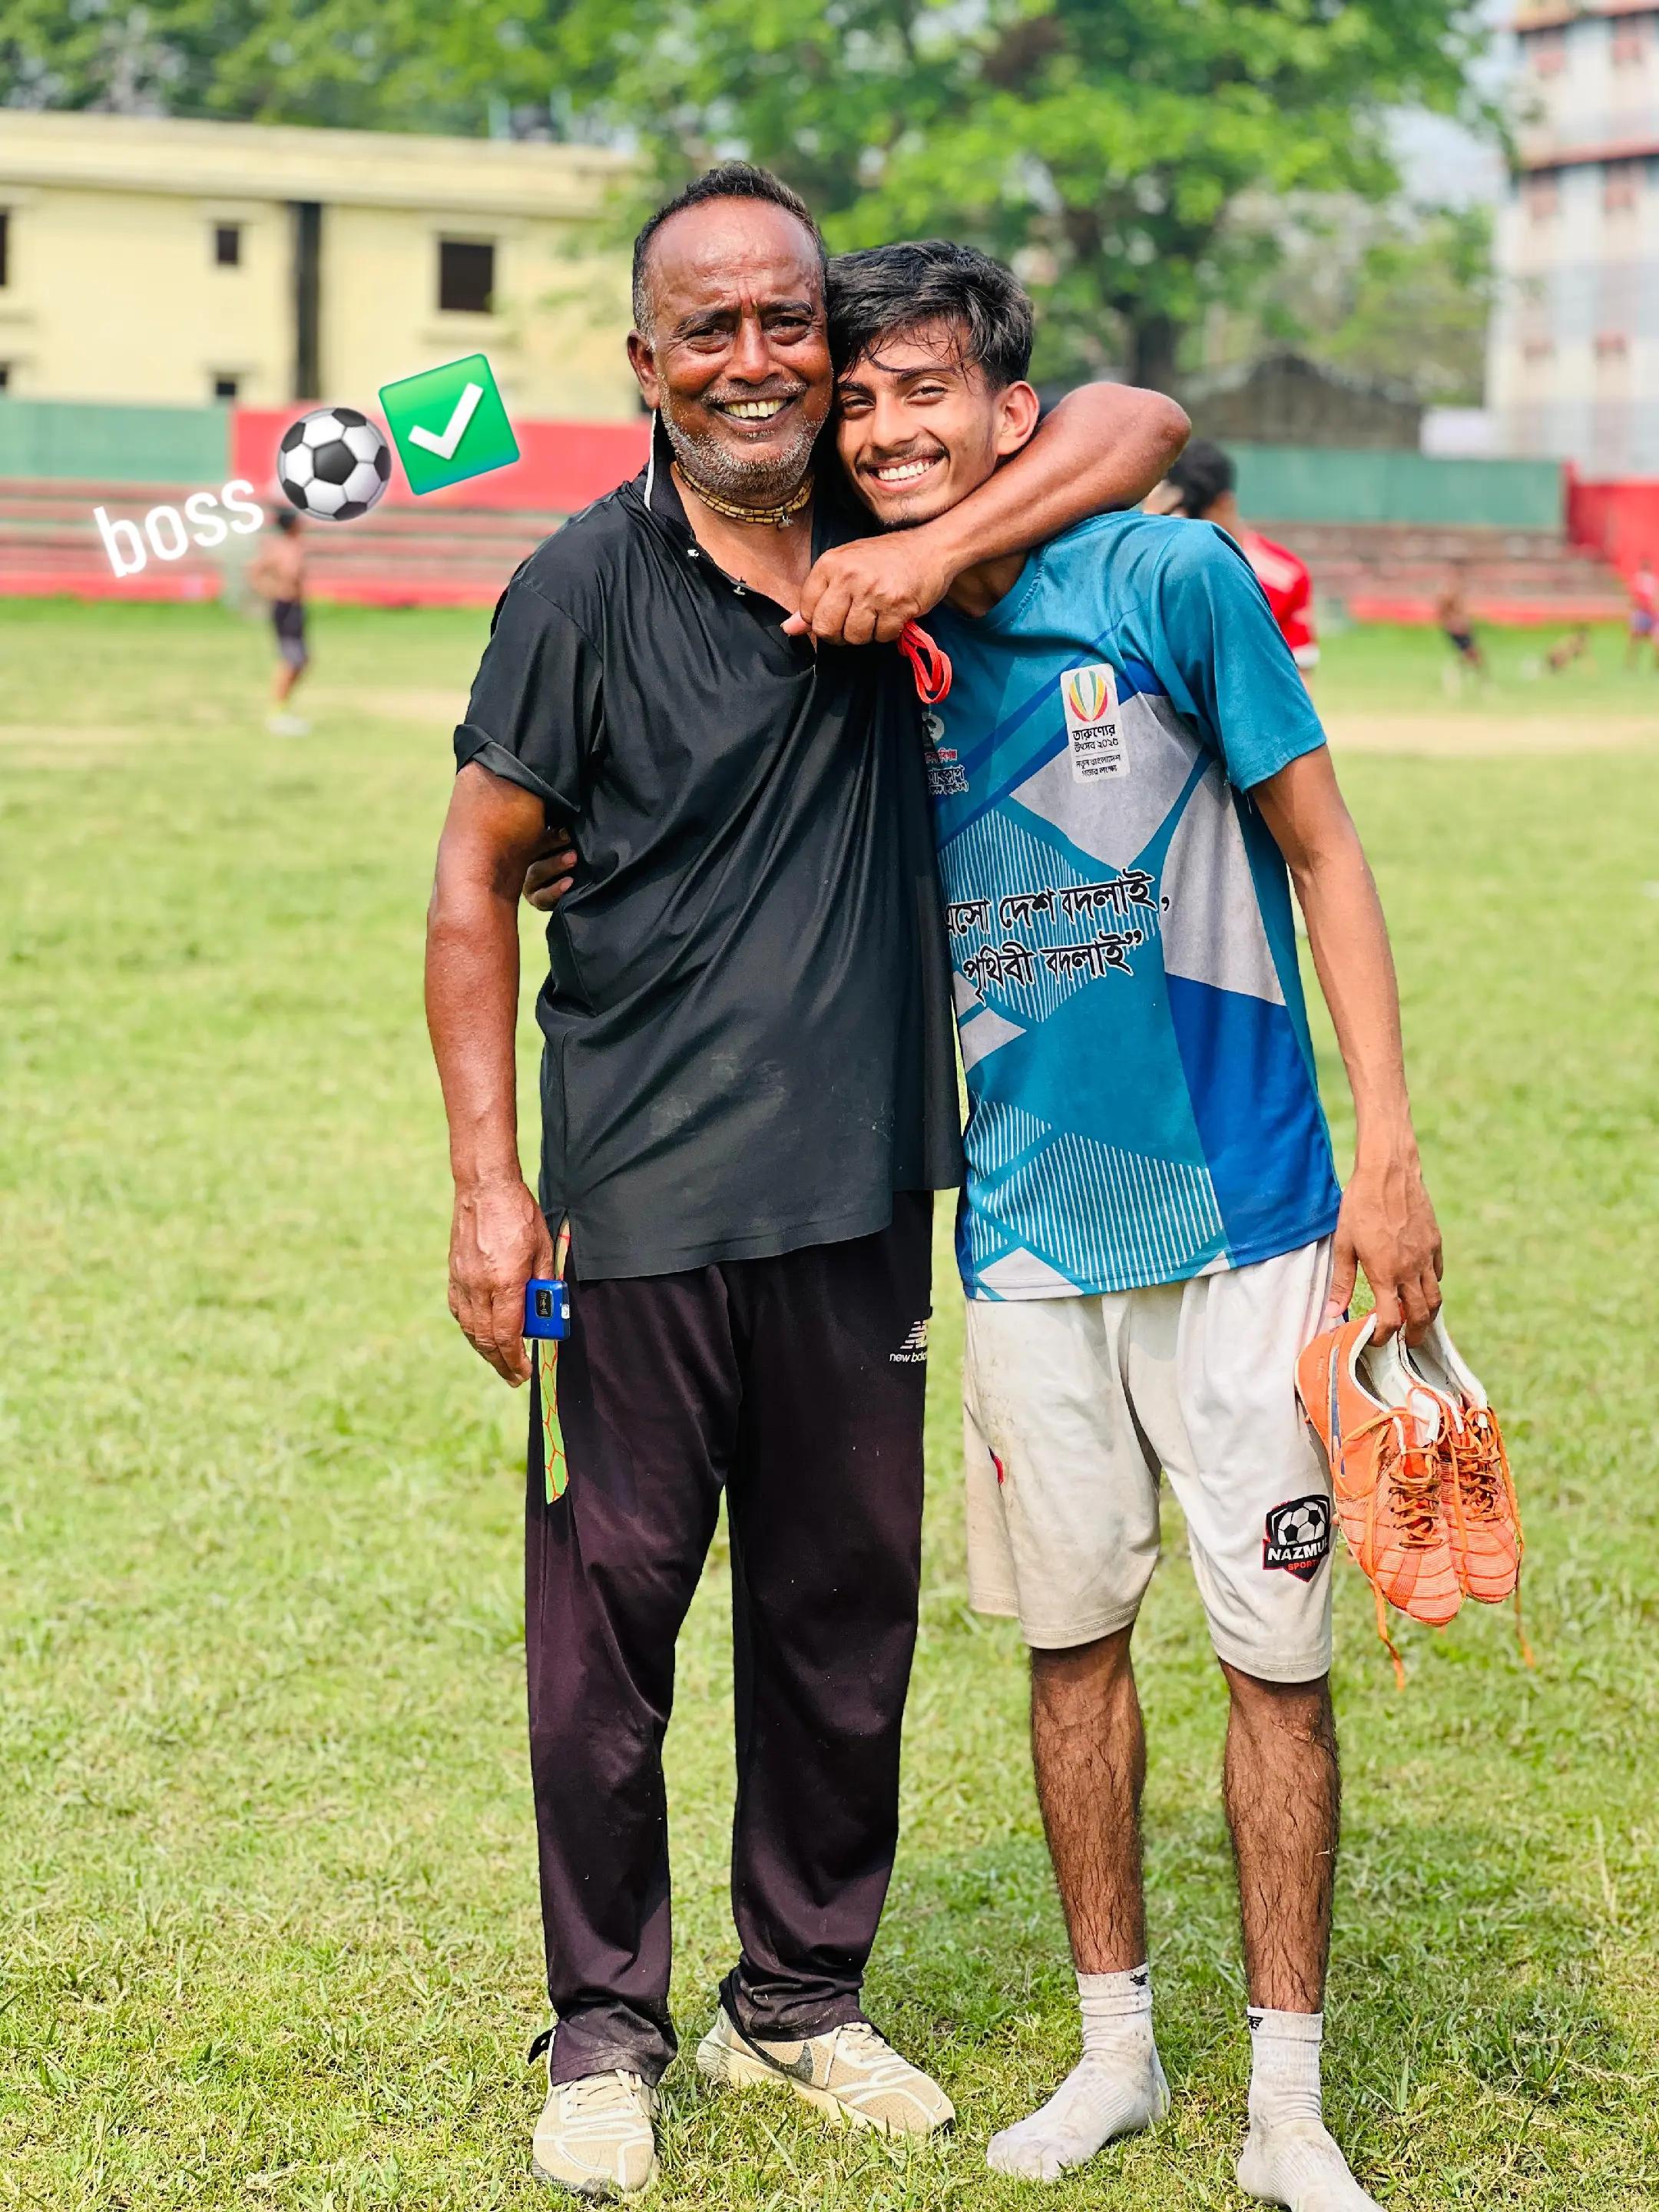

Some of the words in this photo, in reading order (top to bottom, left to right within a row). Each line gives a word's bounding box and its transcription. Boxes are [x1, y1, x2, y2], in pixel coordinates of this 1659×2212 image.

[1072, 724, 1115, 740] তারুণ্যের
[1075, 741, 1095, 752] উৎসব
[1097, 738, 1118, 748] ২০২৫
[1000, 887, 1057, 929] দেশ
[963, 941, 1036, 1007] পৃথিবী
[889, 1353, 911, 1362] new
[1267, 1537, 1328, 1561] NAZMUL
